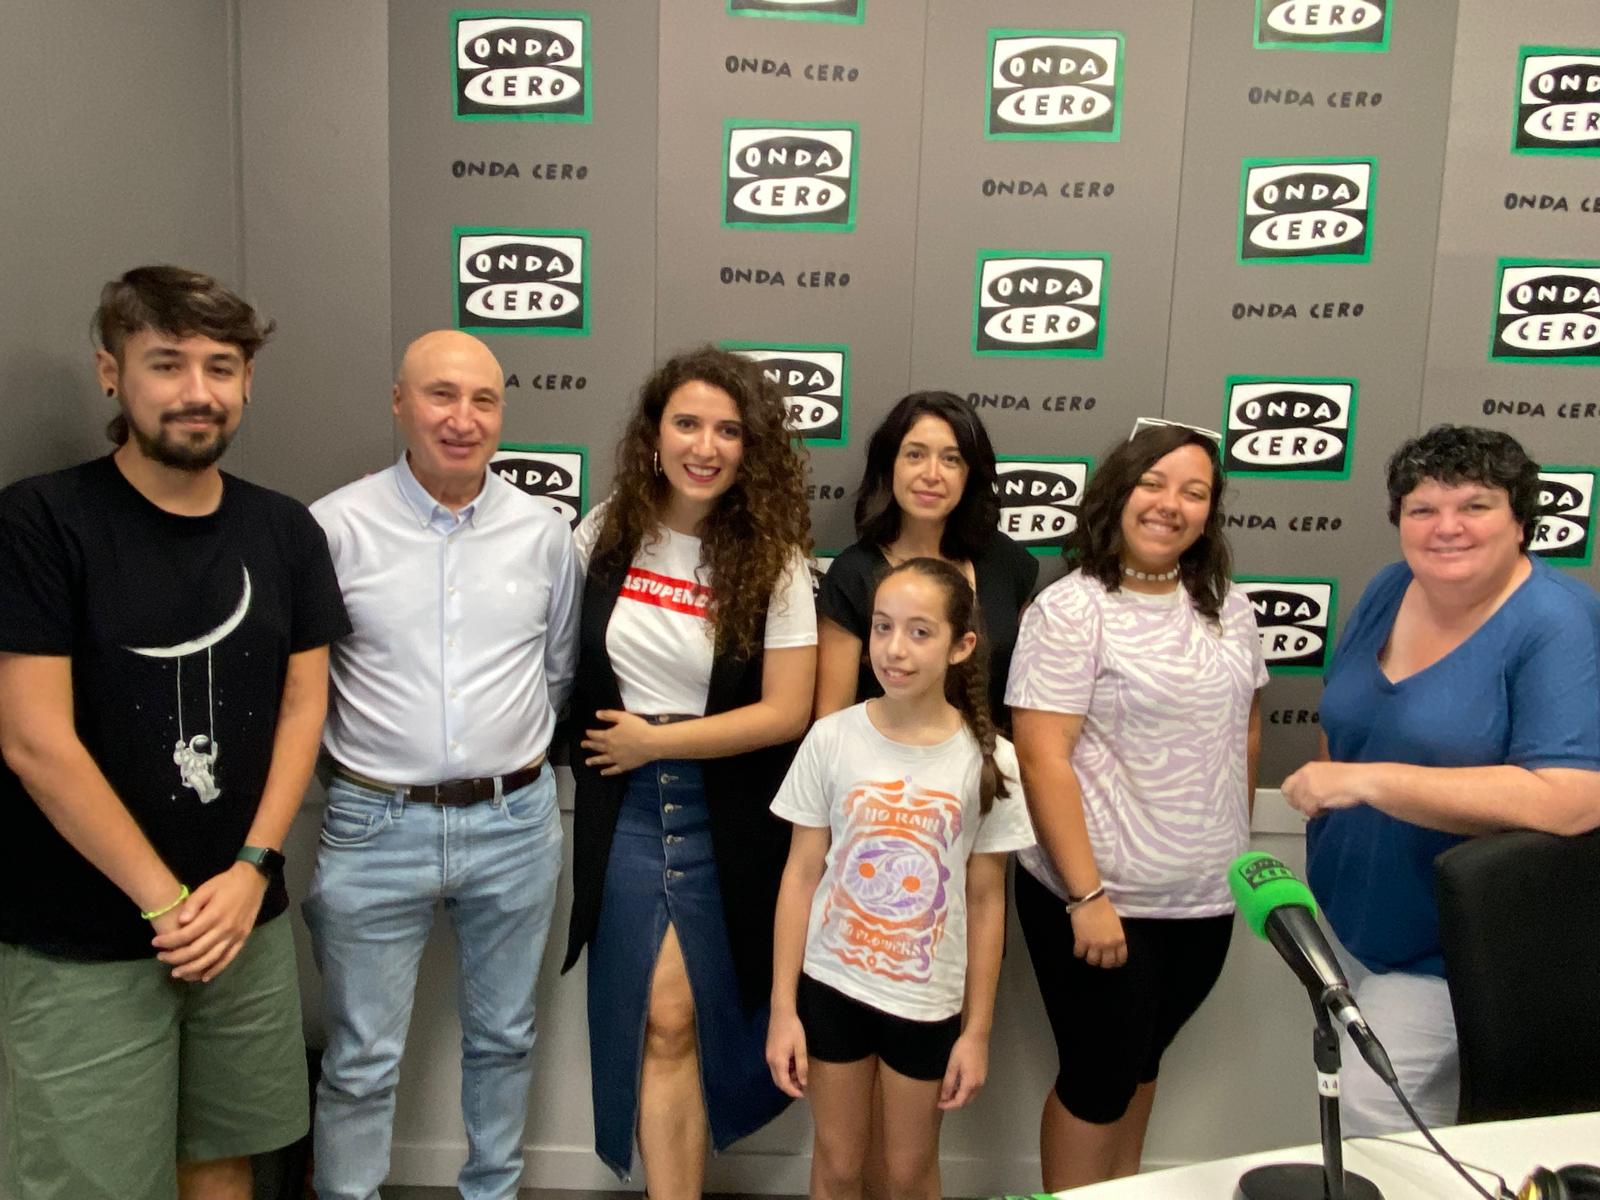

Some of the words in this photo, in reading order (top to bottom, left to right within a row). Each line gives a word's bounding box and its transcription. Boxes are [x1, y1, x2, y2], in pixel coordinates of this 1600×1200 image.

[1283, 4, 1366, 25] CERO
[474, 37, 565, 57] ONDA
[726, 55, 792, 78] ONDA
[804, 64, 860, 82] CERO
[1009, 57, 1099, 77] ONDA
[481, 75, 565, 97] CERO
[1537, 73, 1600, 93] OND
[1013, 94, 1096, 116] CERO
[1248, 86, 1315, 107] ONDA
[1326, 91, 1383, 108] CERO
[1541, 111, 1600, 131] CER
[745, 147, 833, 168] ONDA
[451, 159, 520, 179] ONDA
[531, 163, 588, 180] CERO
[749, 185, 831, 206] CERO
[982, 178, 1048, 198] ONDA
[1060, 181, 1115, 199] CERO
[1263, 183, 1351, 204] ONDA
[1504, 192, 1568, 212] ONDA
[1581, 197, 1600, 213] CE
[1266, 219, 1348, 241] CERO
[475, 253, 565, 273] ONDA
[719, 266, 785, 287] ONDA
[796, 270, 851, 288] CERO
[997, 277, 1083, 297] ONDA
[481, 289, 564, 311] CERO
[1516, 284, 1600, 304] ONDA
[1232, 302, 1297, 319] ONDA
[1309, 302, 1364, 319] CERO
[1000, 313, 1081, 334] CERO
[1517, 321, 1597, 341] CERO
[532, 374, 587, 390] CERO
[763, 369, 825, 387] NDA
[967, 392, 1031, 411] ONDA
[1042, 395, 1096, 412] CERO
[1245, 401, 1331, 420] ONDA
[1482, 399, 1545, 417] ONDA
[1557, 402, 1600, 419] CER
[789, 404, 824, 423] RO
[1247, 435, 1328, 456] CERO
[499, 468, 563, 487] NDA
[806, 484, 845, 500] ERO
[993, 479, 1068, 497] NDA
[1538, 489, 1574, 507] DA
[1007, 513, 1066, 533] ERO
[1288, 516, 1342, 532] CERO
[1535, 523, 1571, 544] RO
[1252, 600, 1311, 617] NDA
[1272, 633, 1309, 652] RO
[1270, 709, 1320, 725] CERO
[895, 811, 940, 833] RAIN
